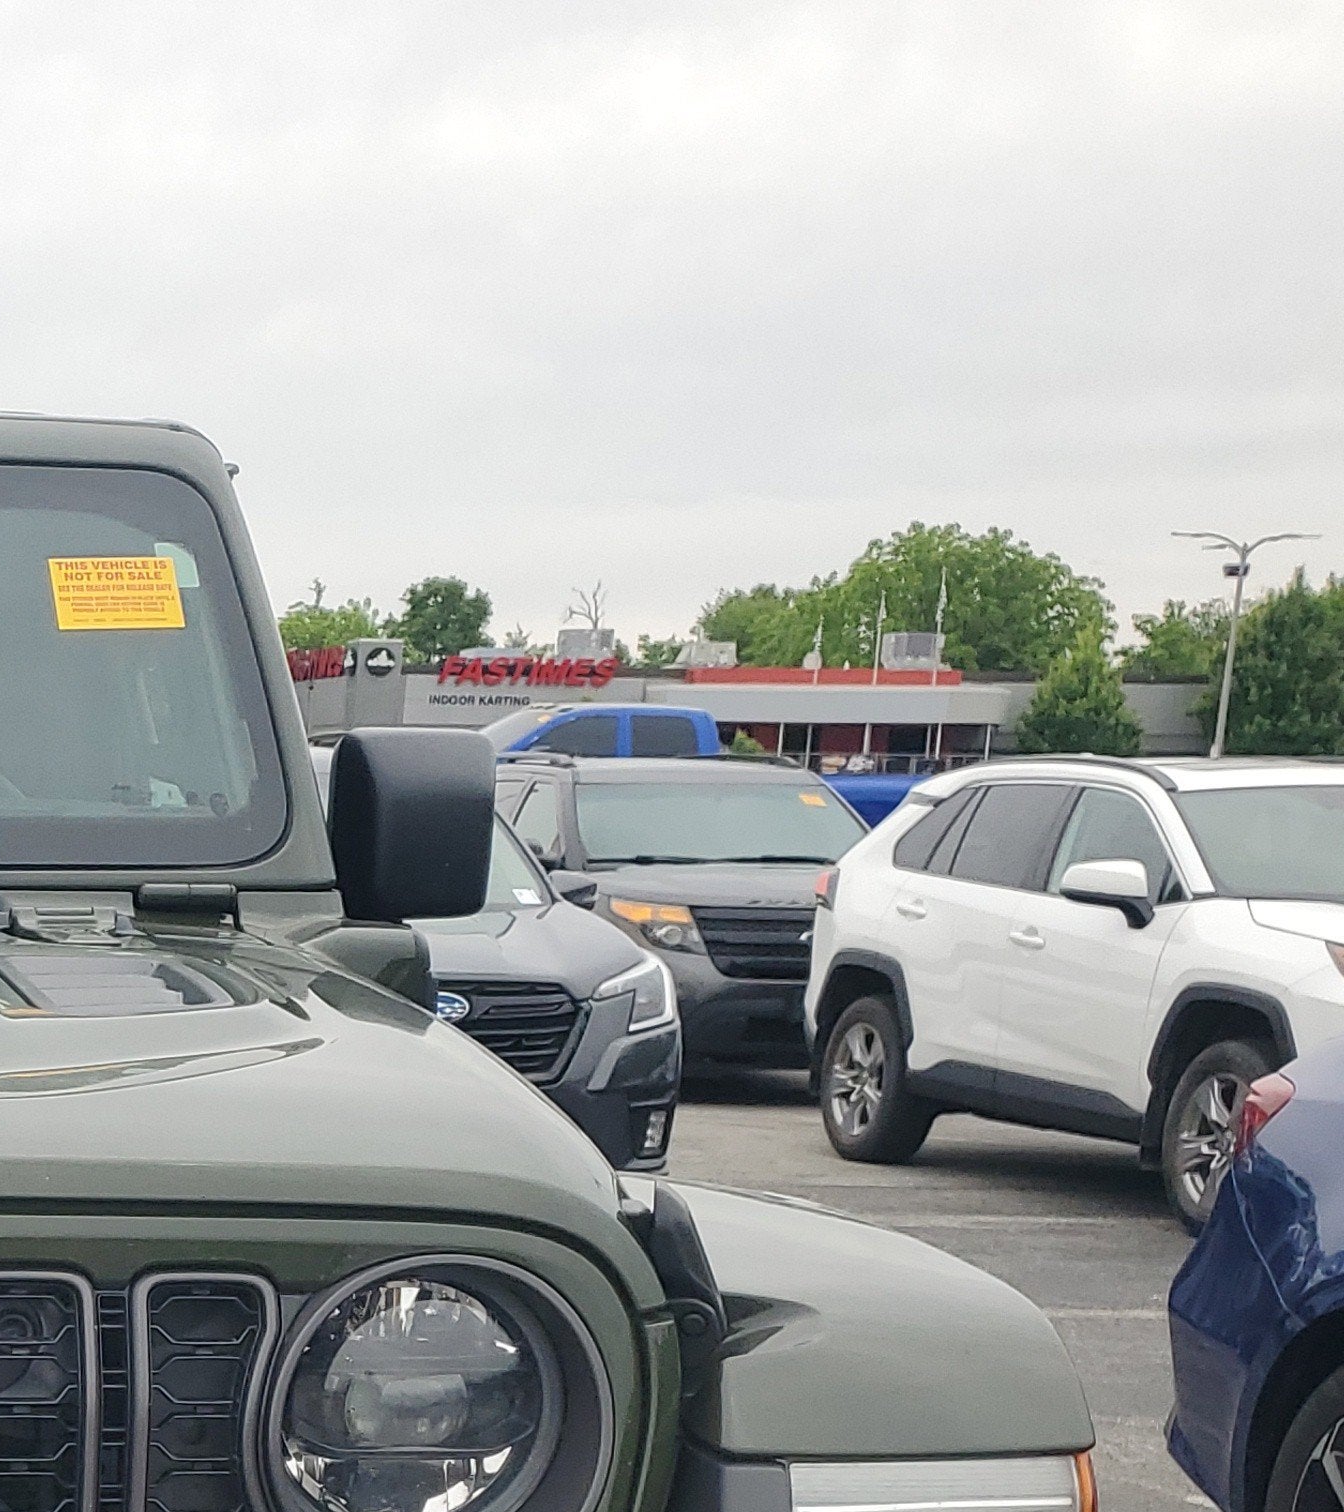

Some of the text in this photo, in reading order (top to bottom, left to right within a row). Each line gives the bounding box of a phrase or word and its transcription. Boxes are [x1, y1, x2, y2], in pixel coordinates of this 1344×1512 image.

[55, 560, 167, 570] THIS VEHICLE IS
[64, 571, 162, 581] NOT FOR SALE
[437, 655, 620, 688] FASTIMES
[428, 695, 531, 706] INDOOR KARTING
